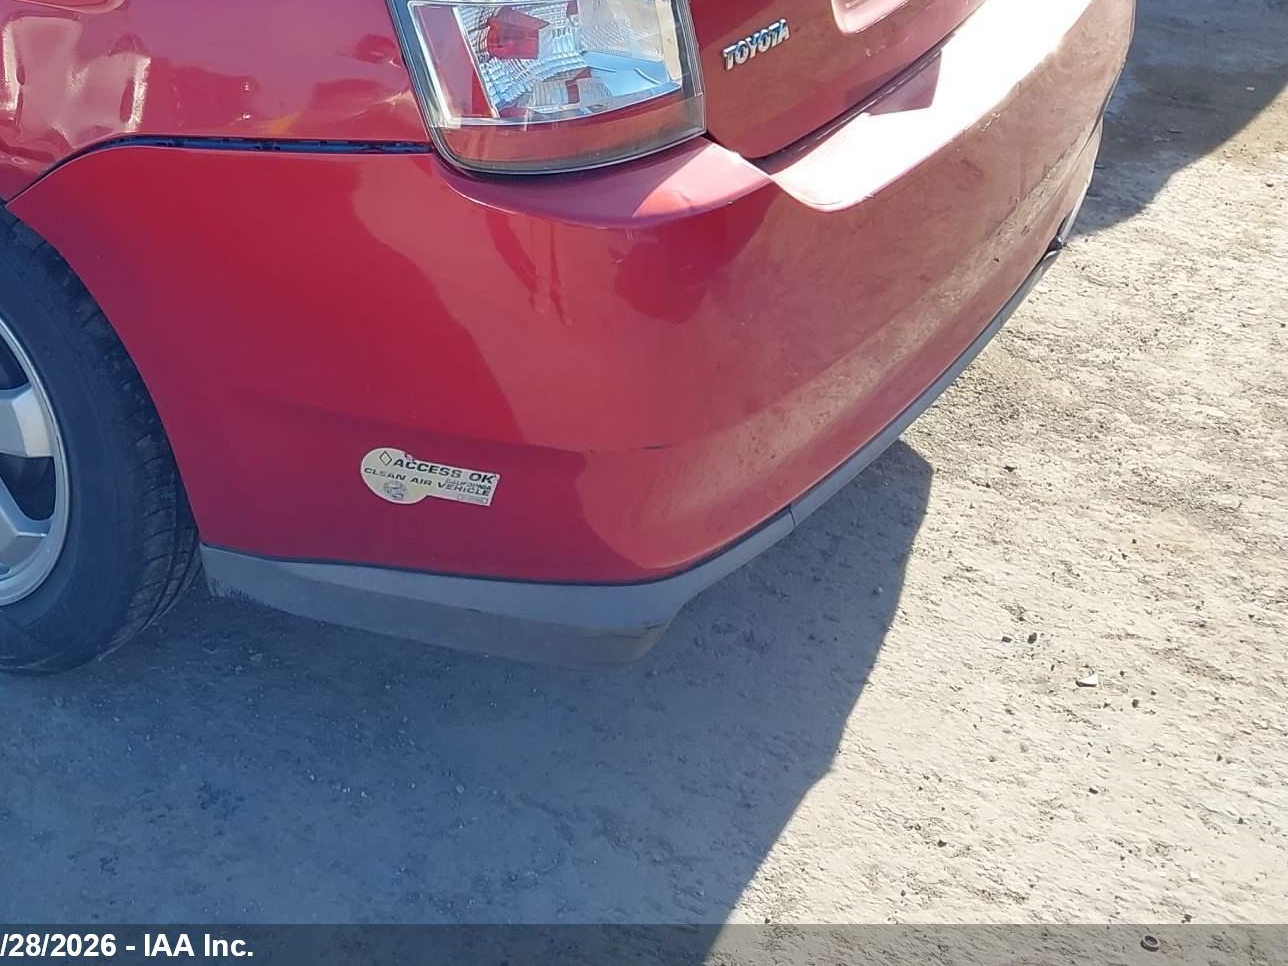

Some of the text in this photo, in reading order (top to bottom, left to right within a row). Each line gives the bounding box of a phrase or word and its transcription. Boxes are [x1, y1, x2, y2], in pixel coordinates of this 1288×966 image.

[723, 18, 790, 71] TOYOTA
[364, 467, 491, 497] CLEAN AIR VEHICLE
[393, 458, 495, 484] ACCESS OK
